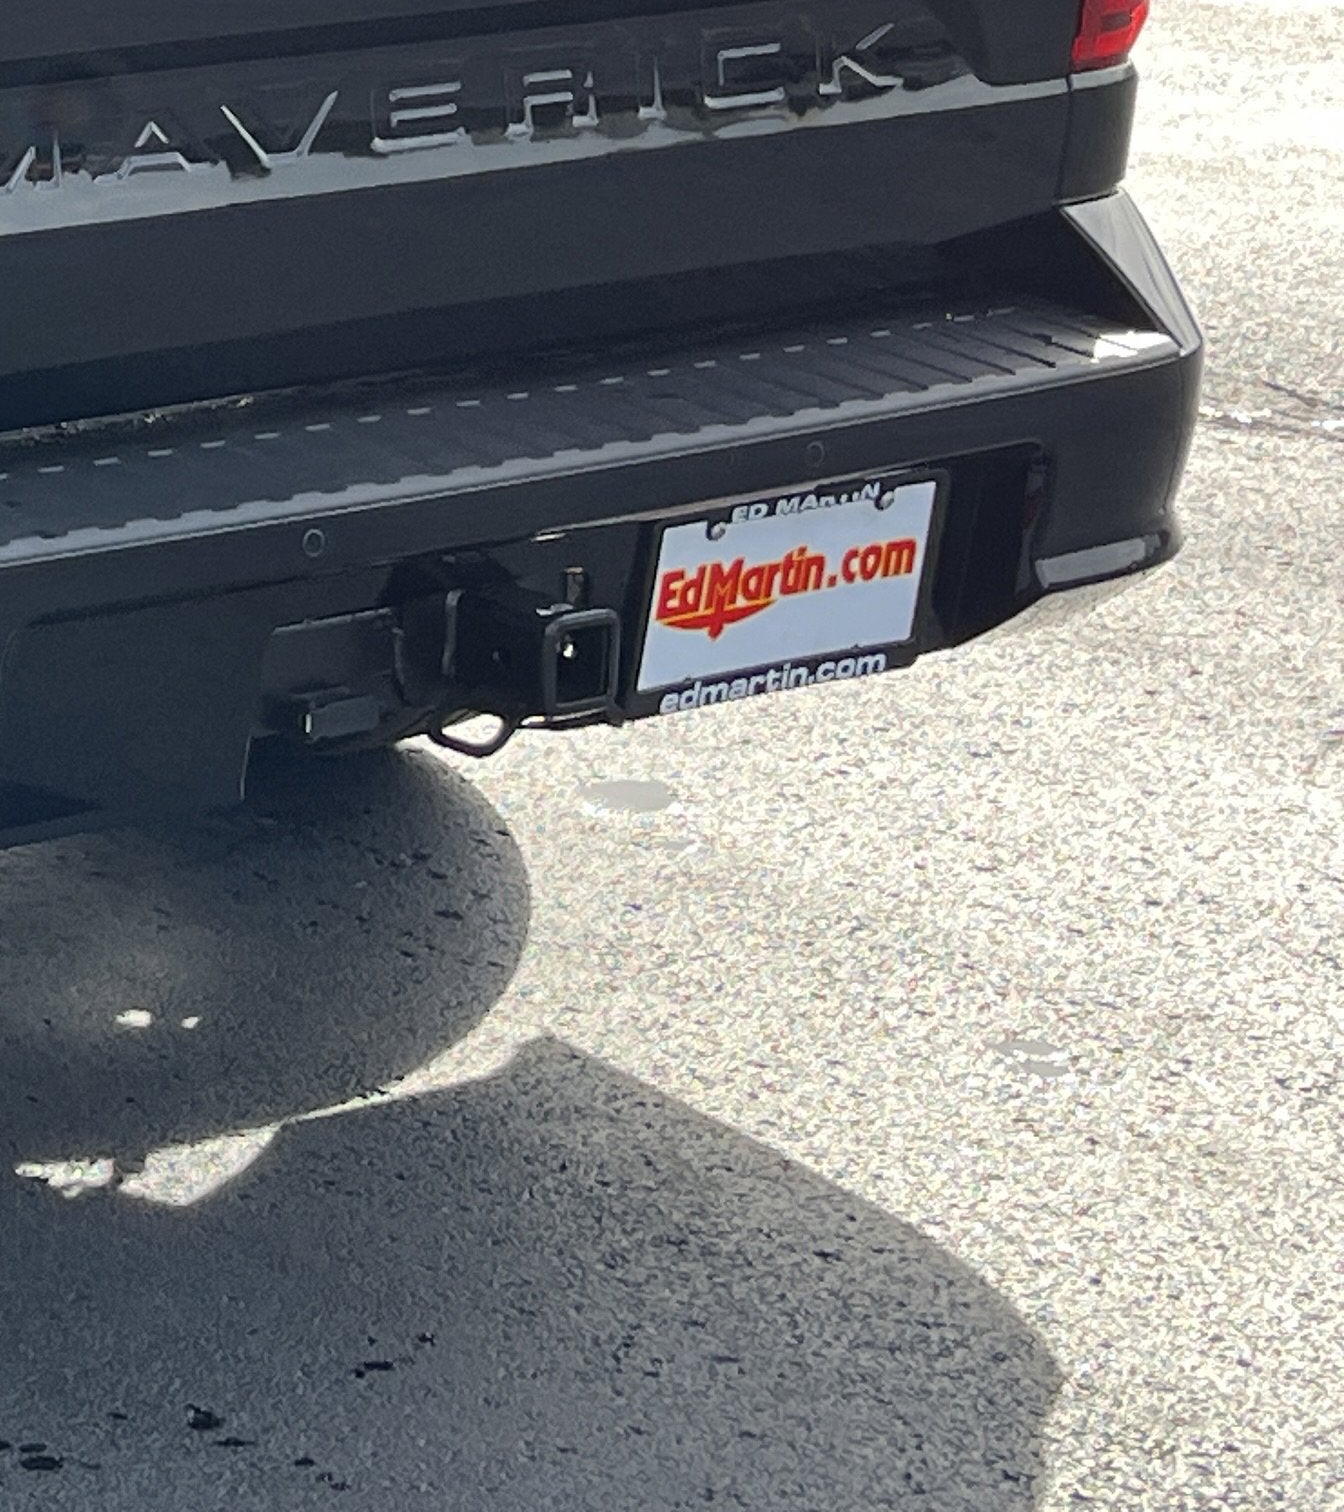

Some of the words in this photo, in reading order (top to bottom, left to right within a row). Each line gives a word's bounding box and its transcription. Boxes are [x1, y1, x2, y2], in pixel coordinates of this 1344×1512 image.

[732, 503, 769, 523] ED
[655, 537, 918, 624] EdMartin.com
[658, 653, 887, 714] edmartin.com
